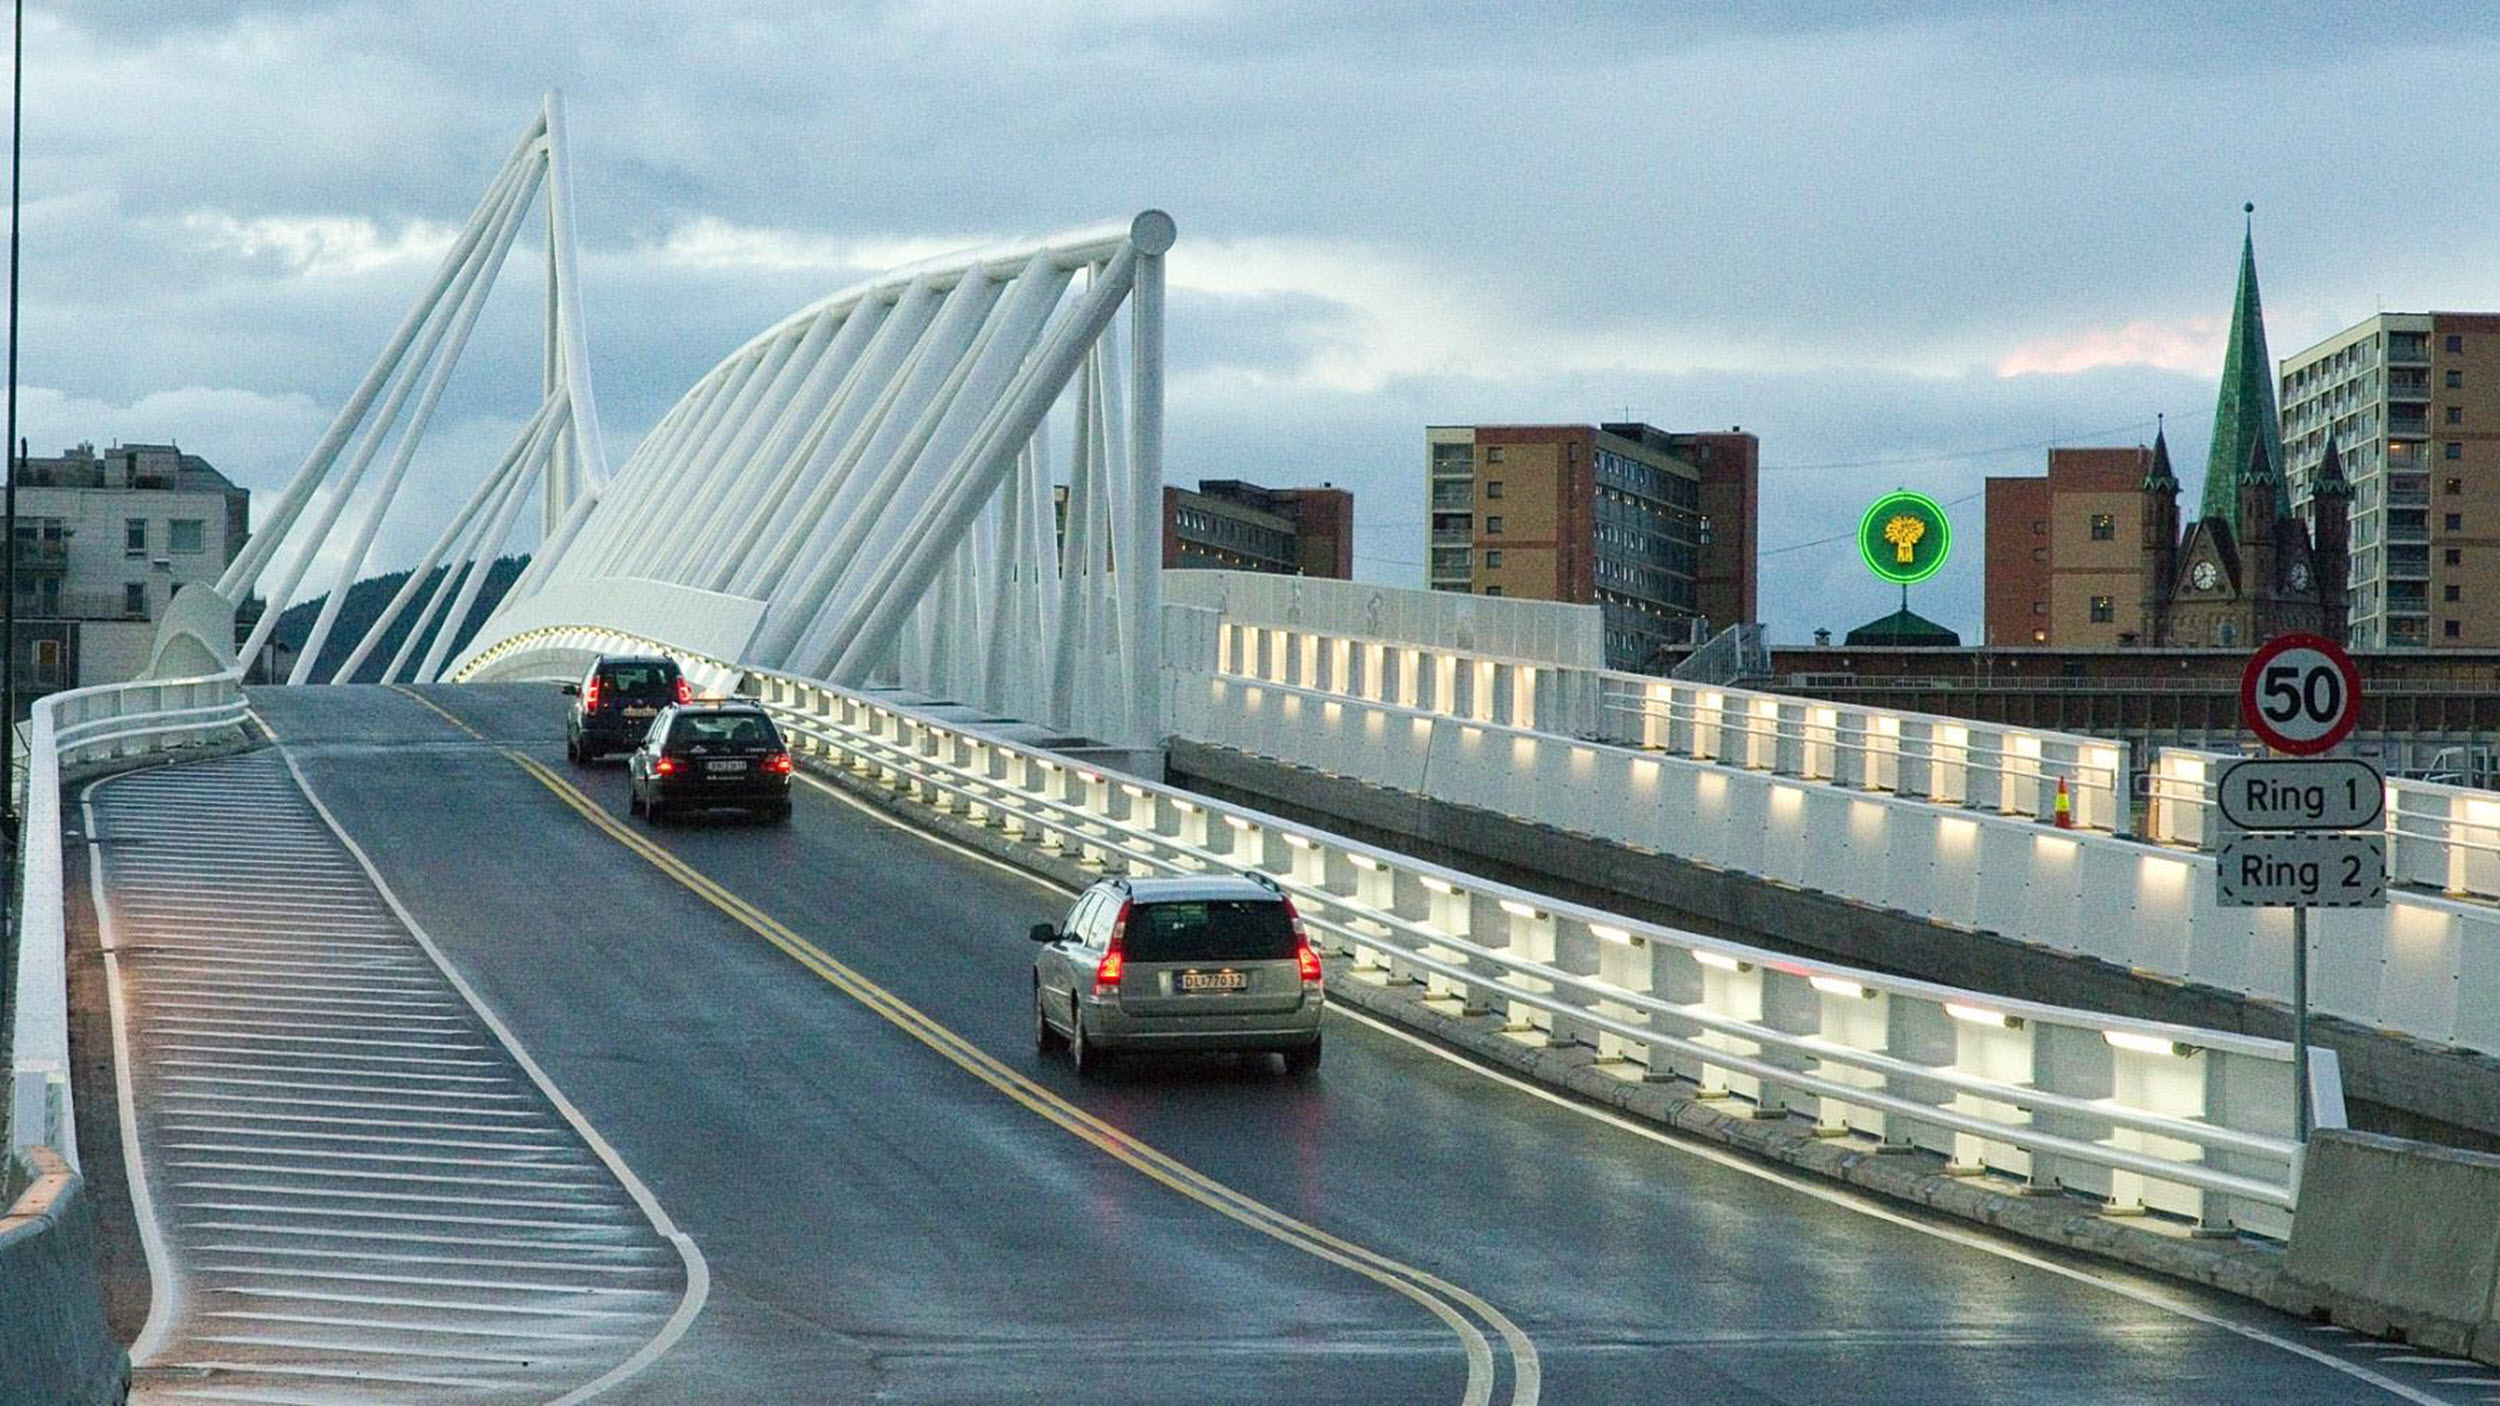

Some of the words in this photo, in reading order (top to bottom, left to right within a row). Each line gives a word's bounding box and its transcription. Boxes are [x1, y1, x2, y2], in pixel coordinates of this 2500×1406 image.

[2263, 666, 2341, 723] 50
[2247, 779, 2324, 818] Ring
[2345, 778, 2356, 810] 1
[2241, 855, 2319, 895] Ring
[2341, 856, 2361, 887] 2
